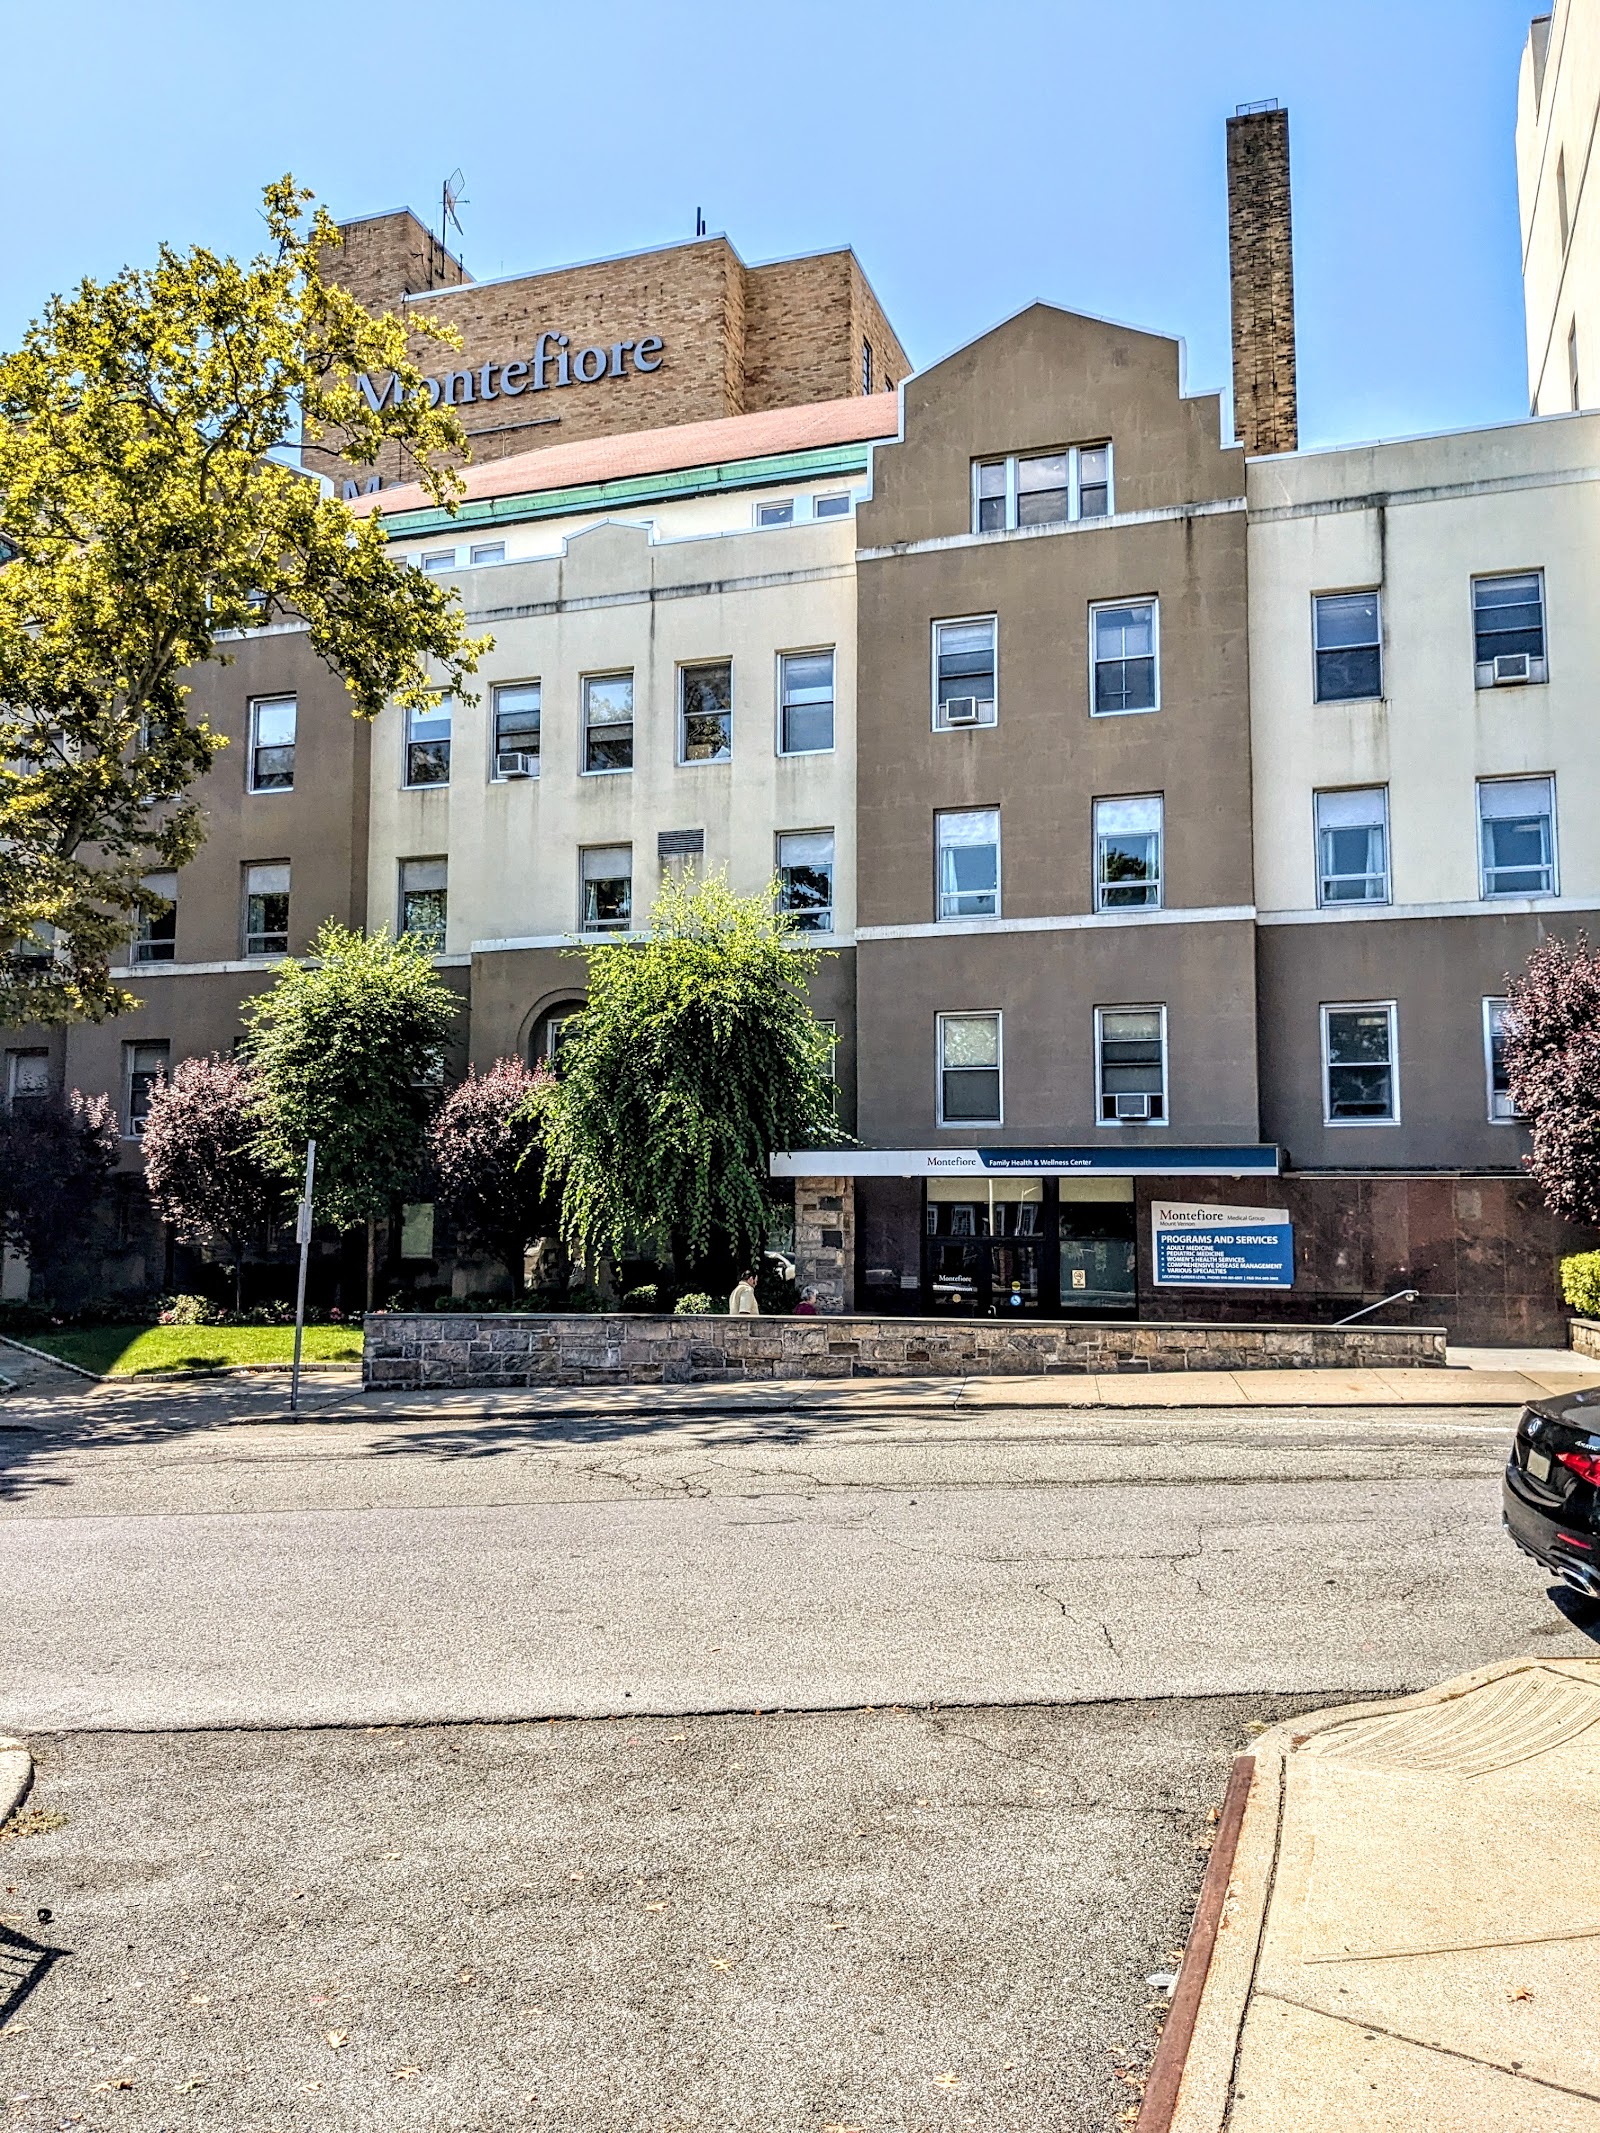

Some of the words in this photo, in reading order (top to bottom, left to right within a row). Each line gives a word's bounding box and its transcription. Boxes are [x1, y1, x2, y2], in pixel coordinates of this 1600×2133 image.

[354, 331, 665, 413] Montefiore
[926, 1156, 977, 1166] Montefiore
[989, 1159, 1010, 1167] Family
[1011, 1158, 1033, 1166] Health
[1159, 1209, 1224, 1221] Montefiore
[1161, 1235, 1212, 1244] PROGRAMS
[1213, 1235, 1235, 1244] AND
[1235, 1235, 1279, 1245] SERVICES
[938, 1274, 972, 1282] Montefiore
